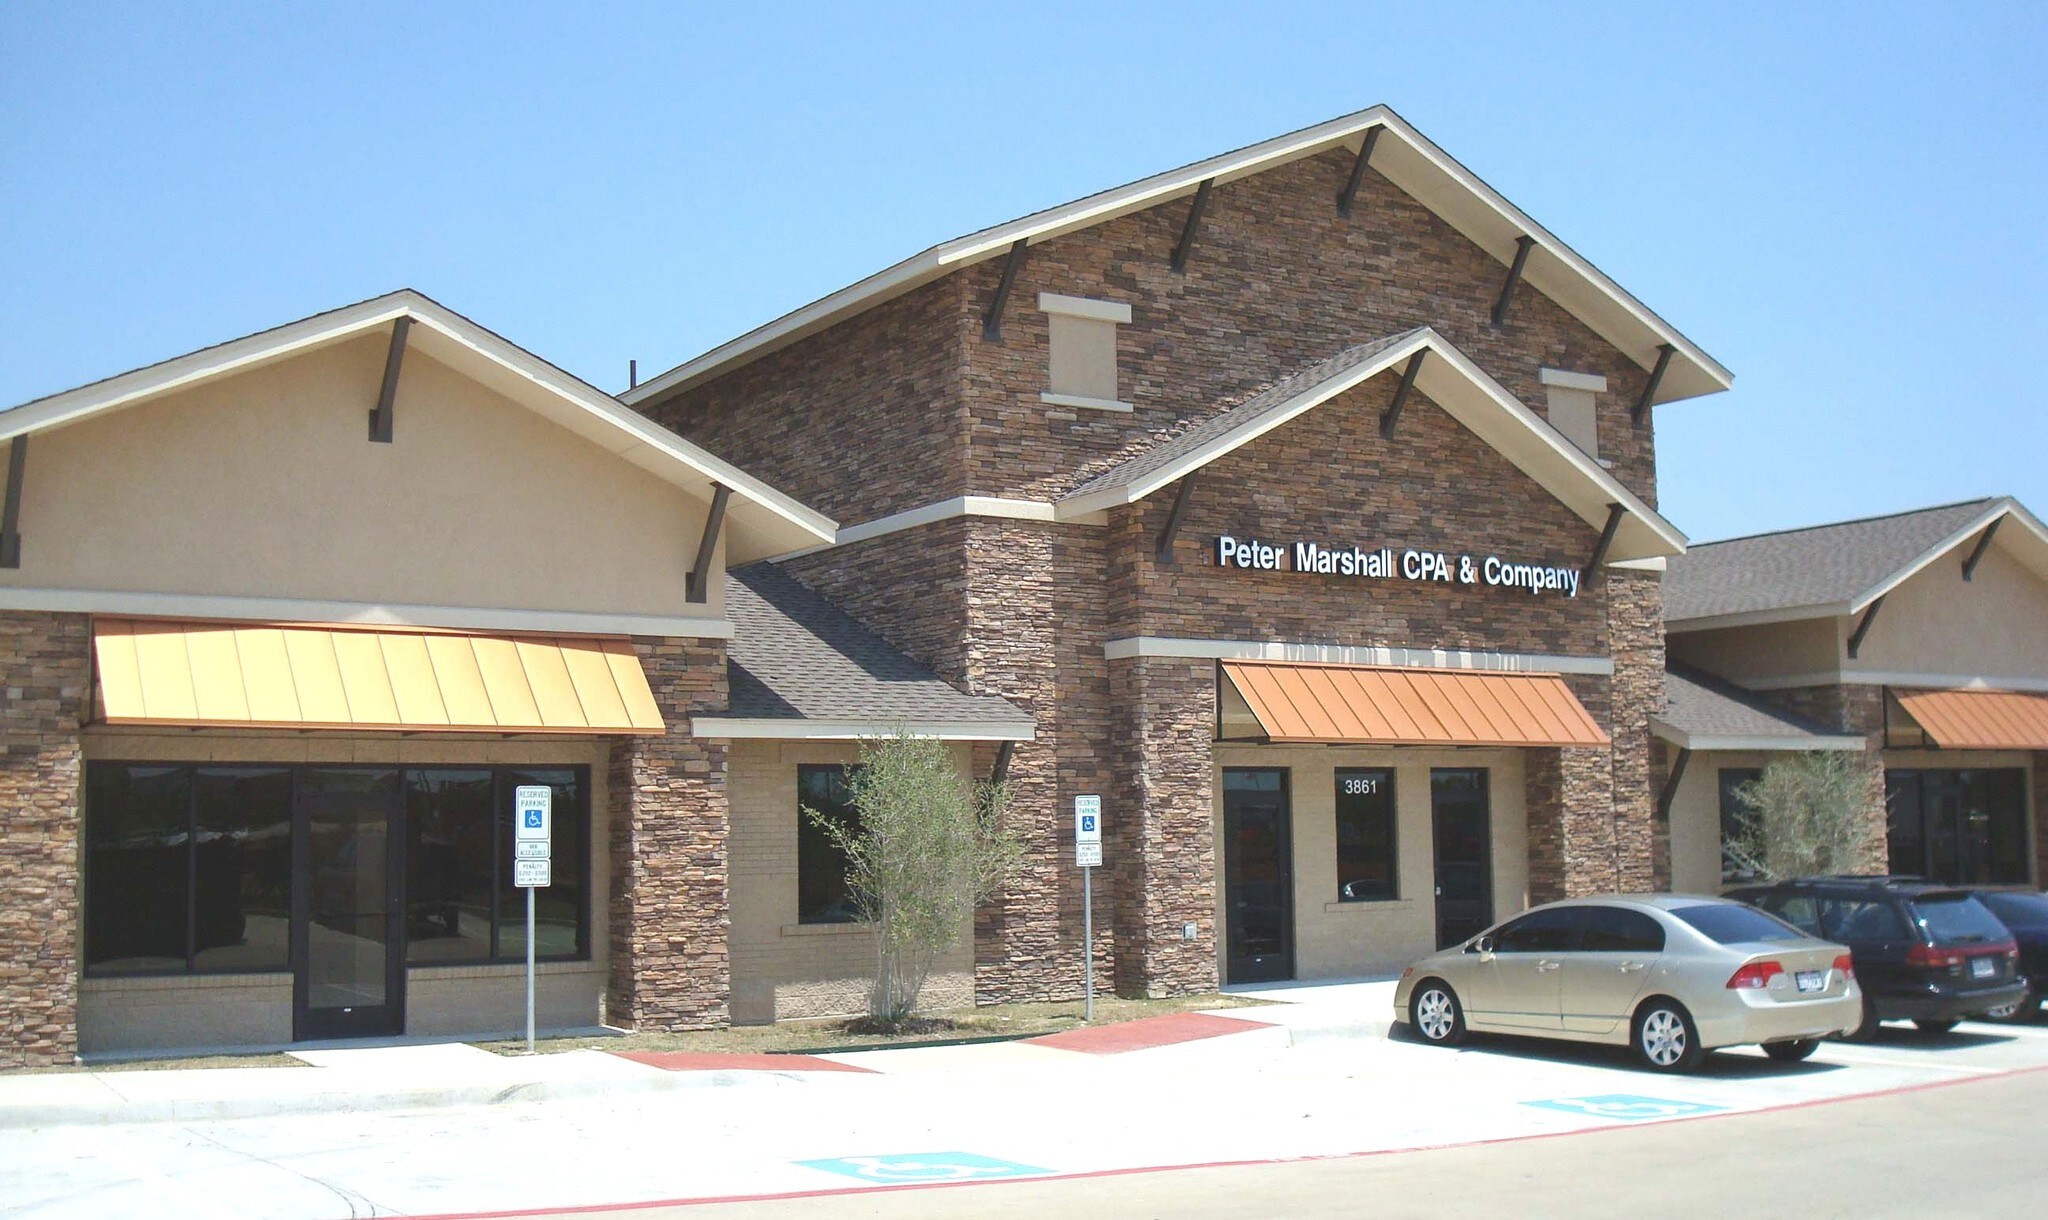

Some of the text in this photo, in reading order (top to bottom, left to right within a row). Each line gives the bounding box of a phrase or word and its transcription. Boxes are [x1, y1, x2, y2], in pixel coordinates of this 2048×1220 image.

[1218, 536, 1581, 597] Peter Marshall CPA & Company
[519, 790, 548, 798] RESERVED
[1345, 779, 1376, 794] 3861
